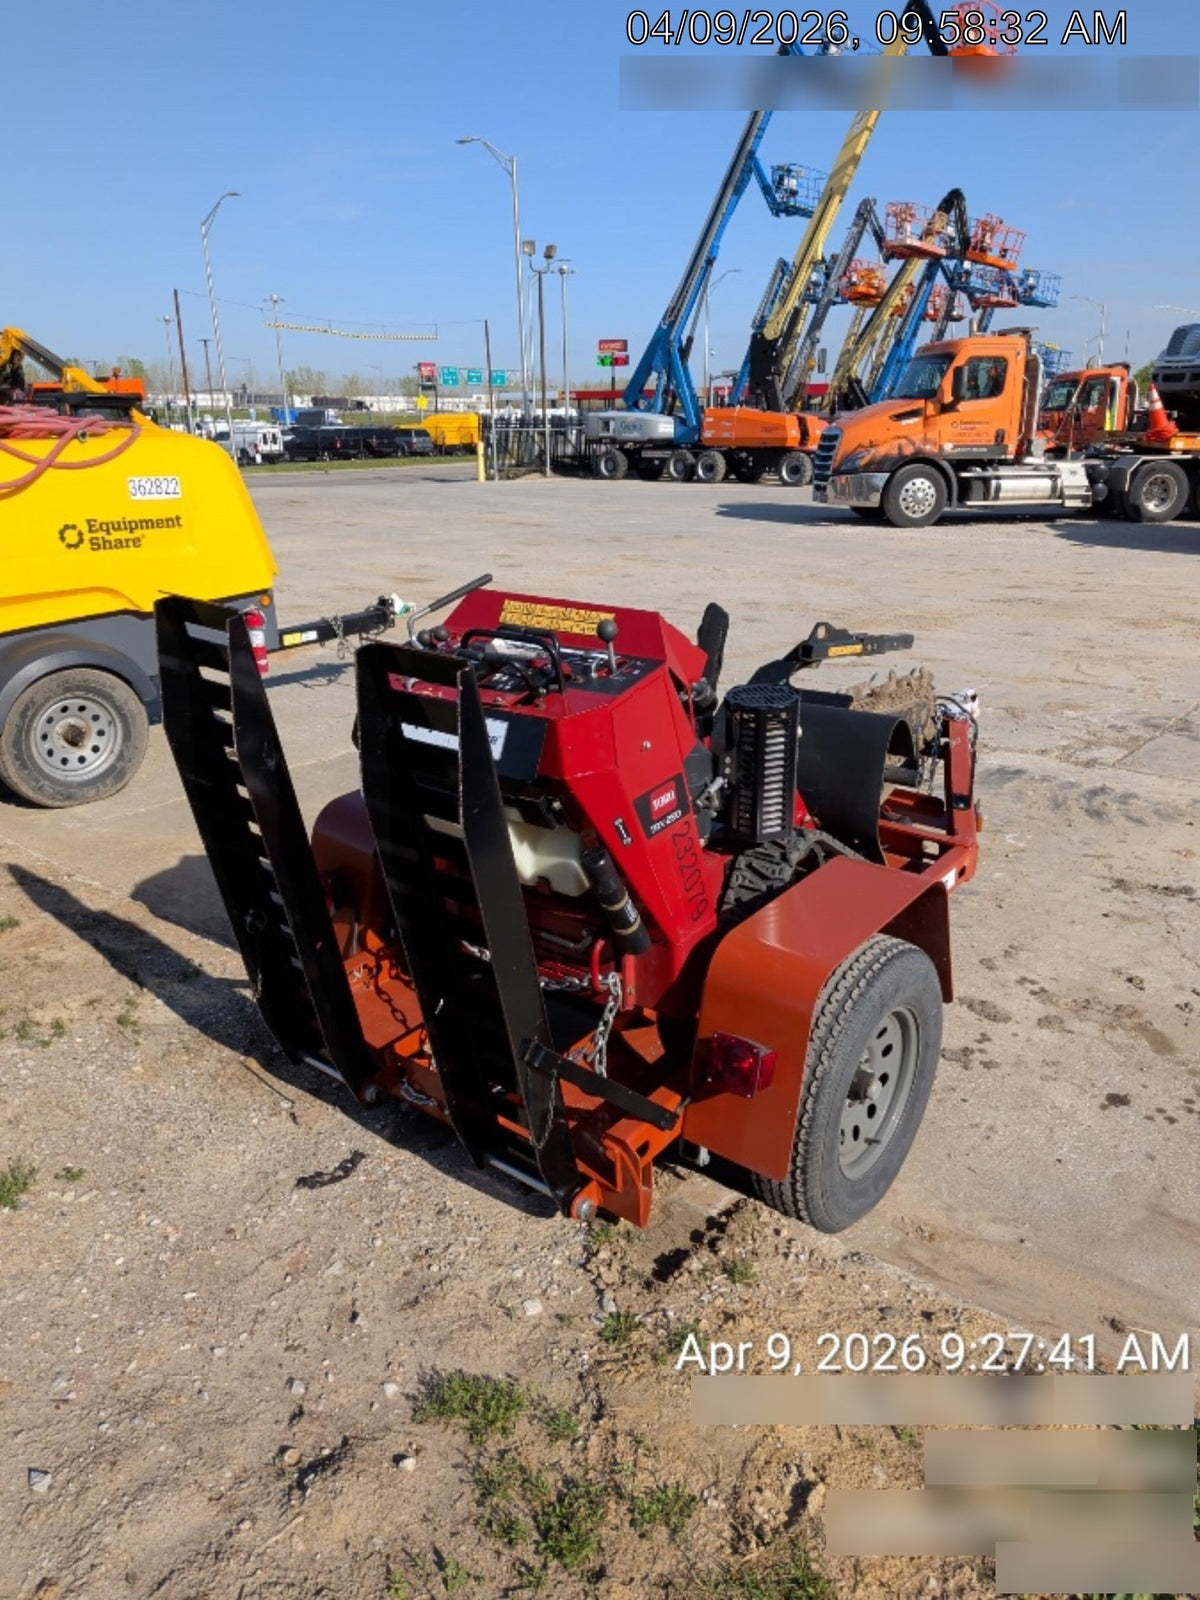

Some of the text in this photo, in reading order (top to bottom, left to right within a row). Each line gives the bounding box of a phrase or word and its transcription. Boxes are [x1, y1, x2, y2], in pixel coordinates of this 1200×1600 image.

[128, 477, 180, 497] 362822
[86, 515, 182, 535] Equipment
[89, 535, 142, 551] Share
[671, 820, 709, 922] 232079
